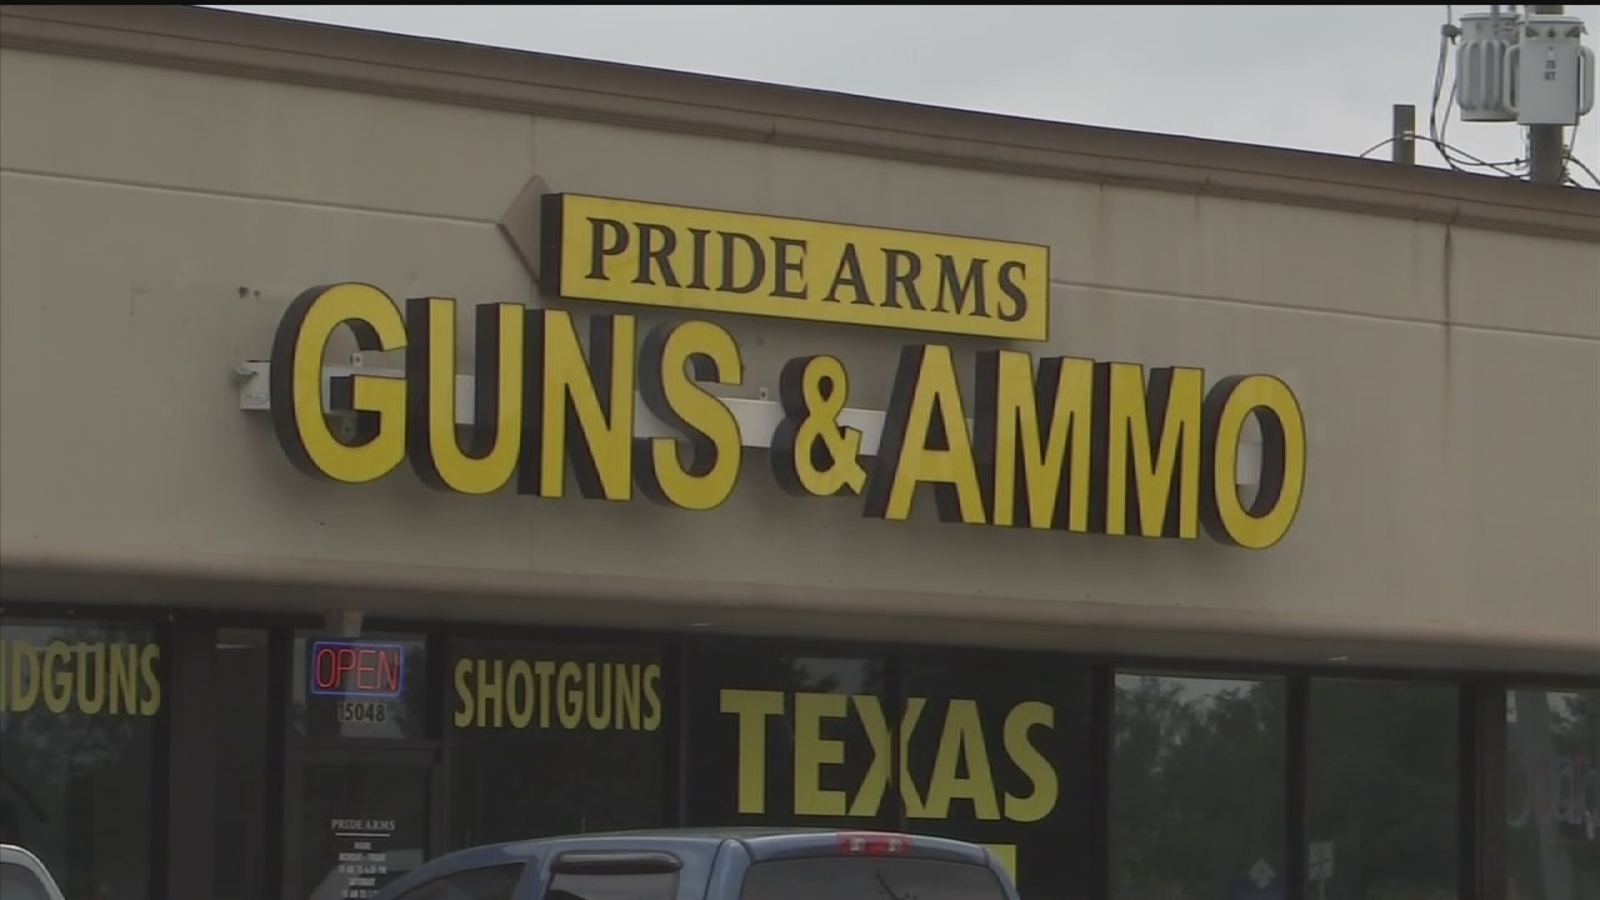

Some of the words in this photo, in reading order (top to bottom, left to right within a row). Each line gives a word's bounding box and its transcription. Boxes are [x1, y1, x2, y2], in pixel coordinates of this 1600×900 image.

[585, 216, 808, 300] PRIDE
[822, 242, 1028, 323] ARMS
[273, 282, 743, 510] GUNS
[780, 354, 868, 497] &
[870, 343, 1307, 550] AMMO
[315, 648, 400, 691] OPEN
[453, 658, 662, 732] SHOTGUNS
[338, 702, 387, 722] 15048
[719, 688, 1060, 823] TEXAS
[331, 819, 362, 829] PRIDE
[364, 820, 396, 830] ARMS
